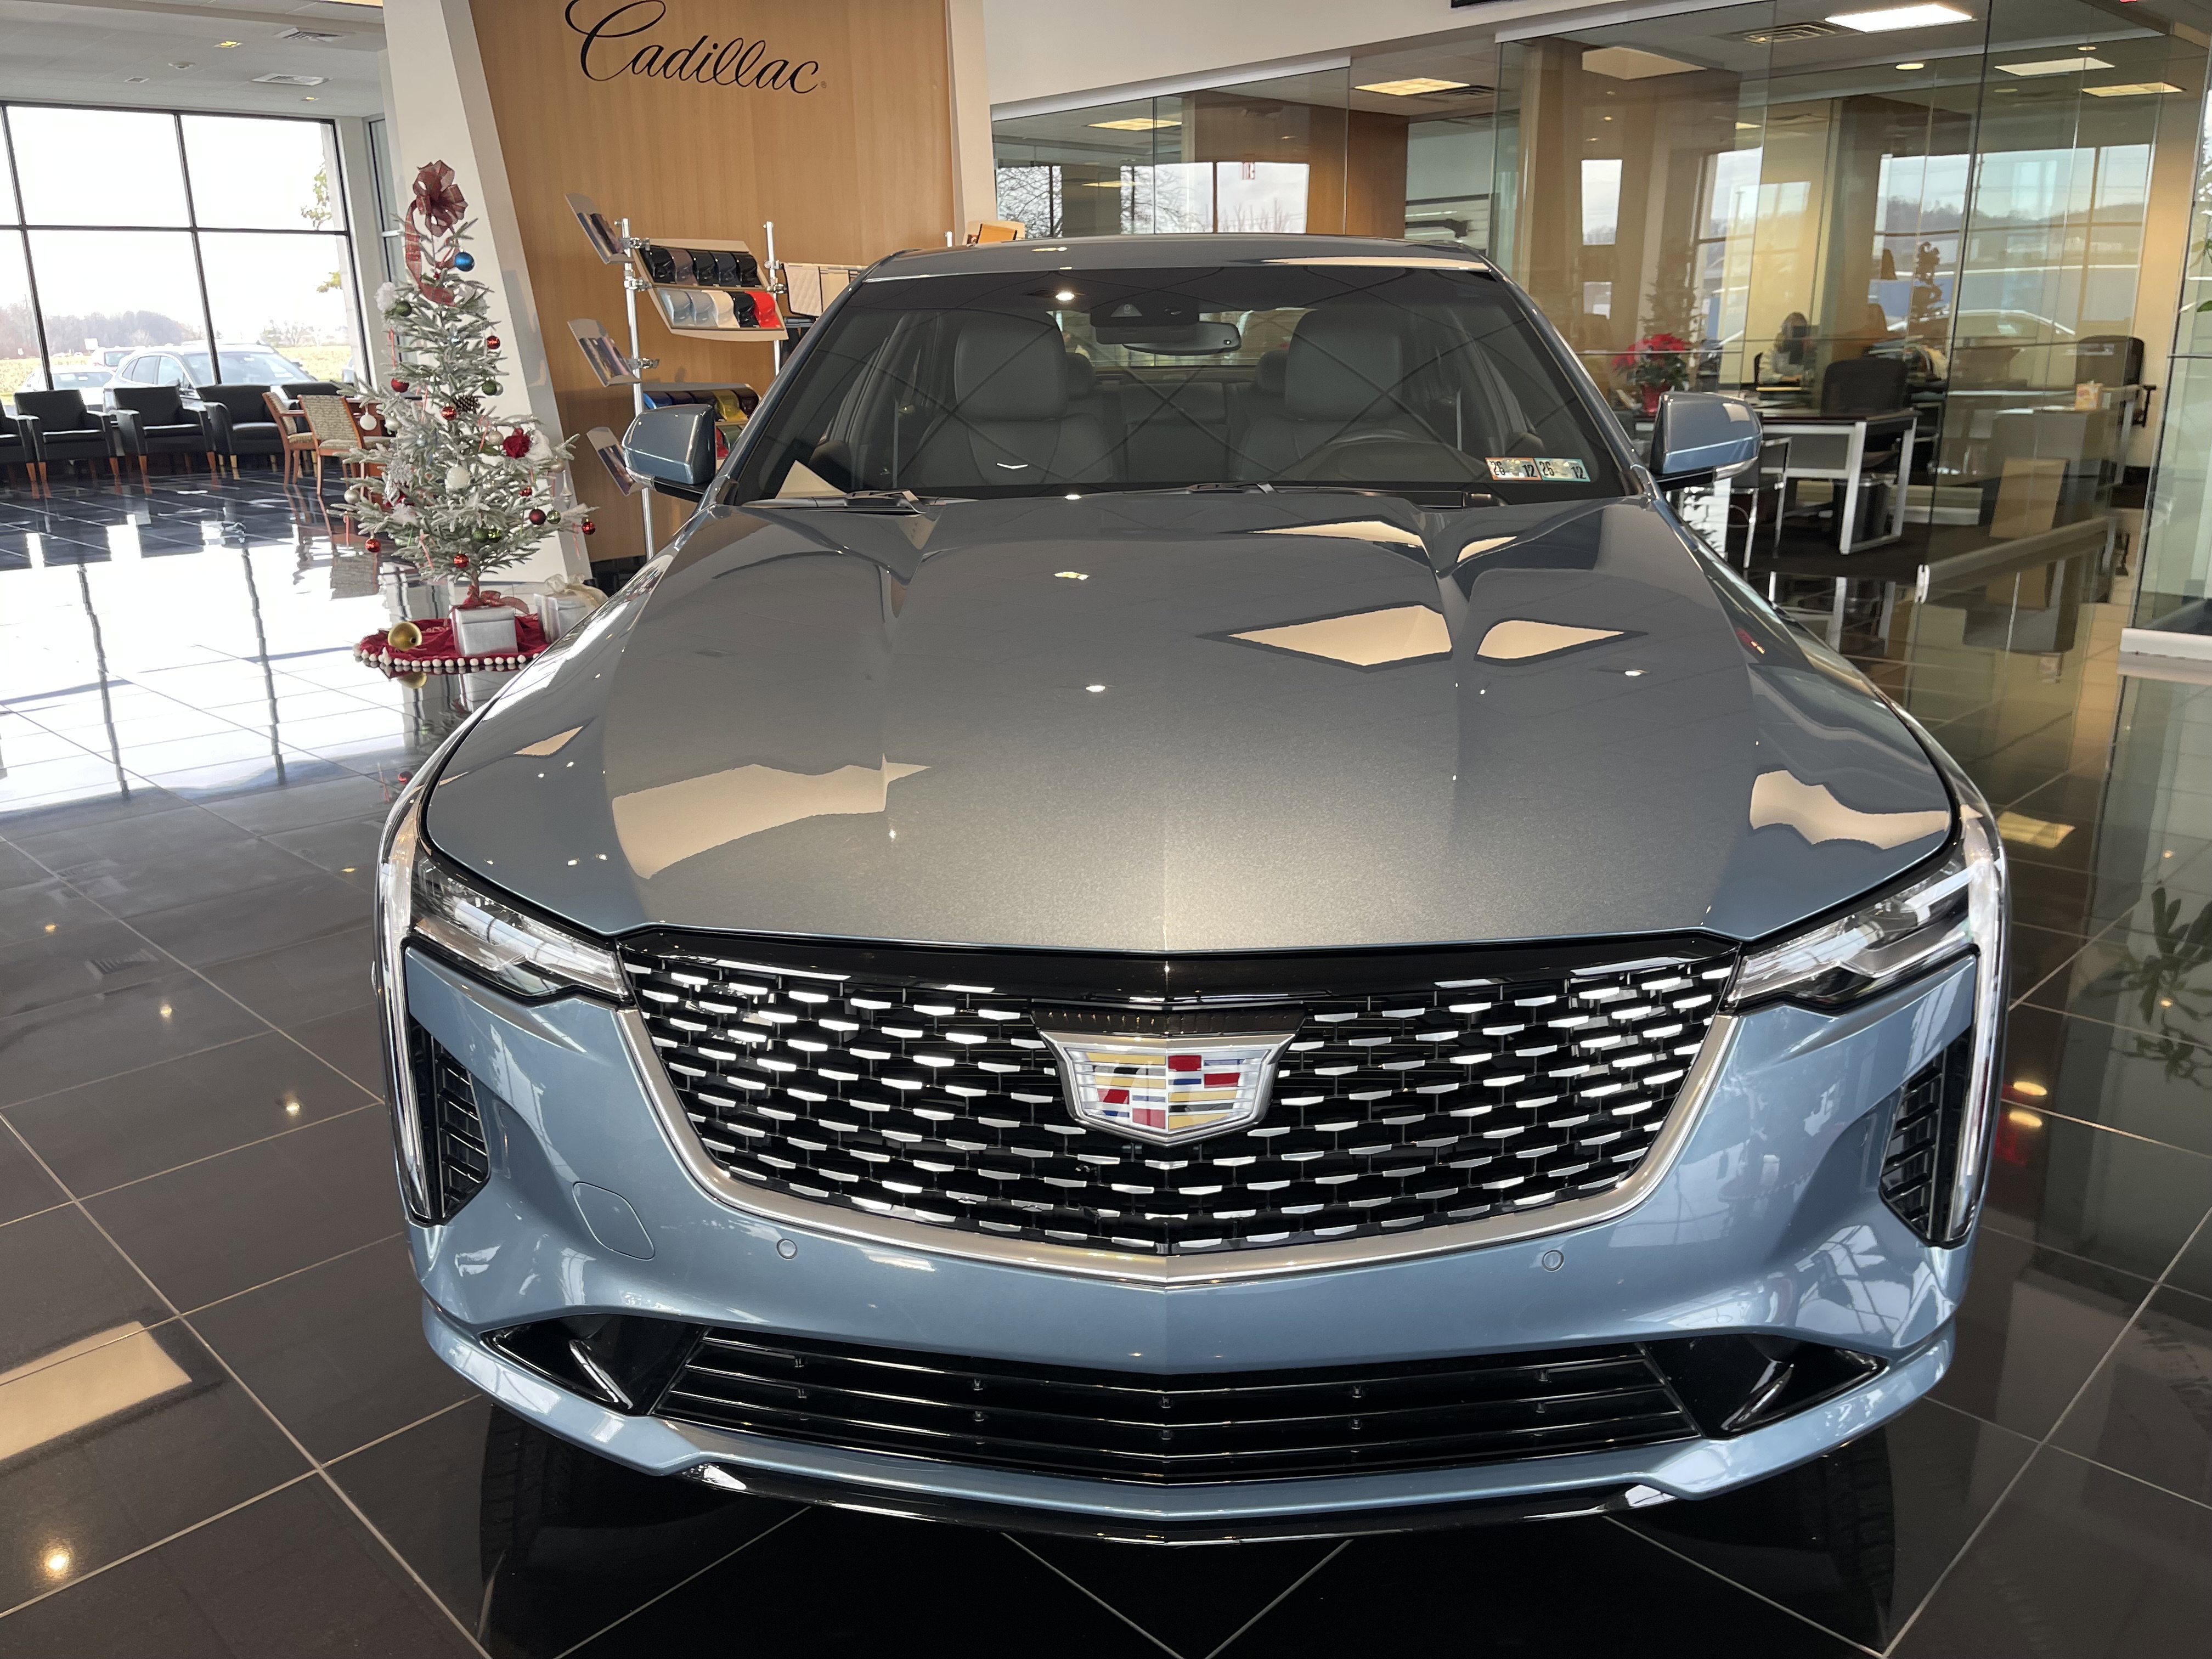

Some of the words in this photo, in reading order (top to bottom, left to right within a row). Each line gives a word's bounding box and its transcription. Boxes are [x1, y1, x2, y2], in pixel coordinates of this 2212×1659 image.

[565, 0, 819, 94] Cadillac
[1522, 465, 1537, 477] 12
[1571, 466, 1586, 479] 12
